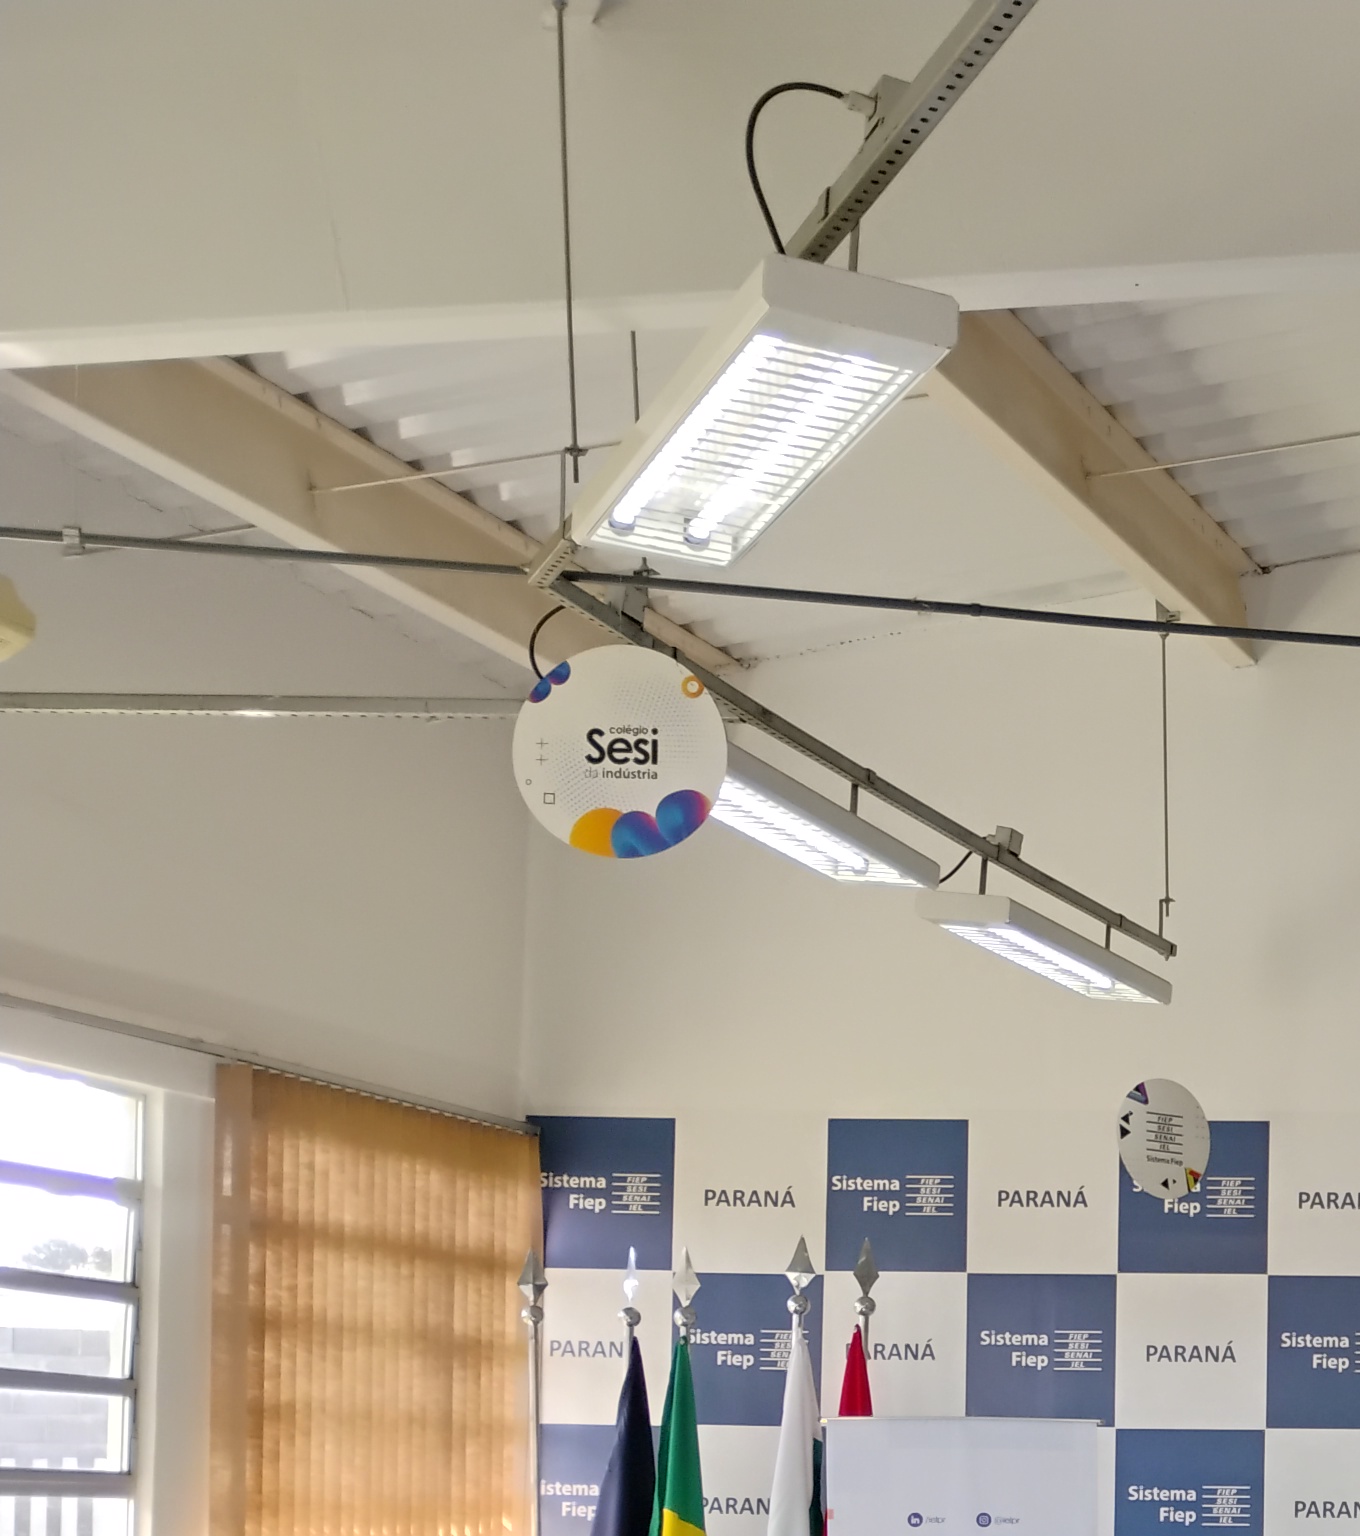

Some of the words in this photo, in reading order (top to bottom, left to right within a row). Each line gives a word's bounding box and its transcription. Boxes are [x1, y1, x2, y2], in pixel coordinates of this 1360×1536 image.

[609, 725, 648, 736] colégio
[585, 728, 659, 765] Sesi
[602, 768, 658, 780] indústria
[1154, 1134, 1176, 1142] SENAI
[1146, 1155, 1170, 1165] Sistema
[1170, 1158, 1183, 1166] Fiep
[539, 1173, 606, 1189] Sistema
[832, 1175, 899, 1190] Sistema
[569, 1194, 606, 1213] Fiep
[705, 1186, 795, 1207] PARANÁ
[998, 1186, 1088, 1207] PARANÁ
[864, 1197, 899, 1215] Fiep
[981, 1330, 1048, 1345] Sistema
[1281, 1332, 1349, 1347] Sistema
[717, 1350, 754, 1369] Fiep
[1147, 1341, 1236, 1362] PARANÁ
[1012, 1352, 1048, 1370] Fiep
[1313, 1354, 1349, 1372] Fiep
[1128, 1486, 1196, 1501] Sistema
[1160, 1507, 1196, 1526] Fiep
